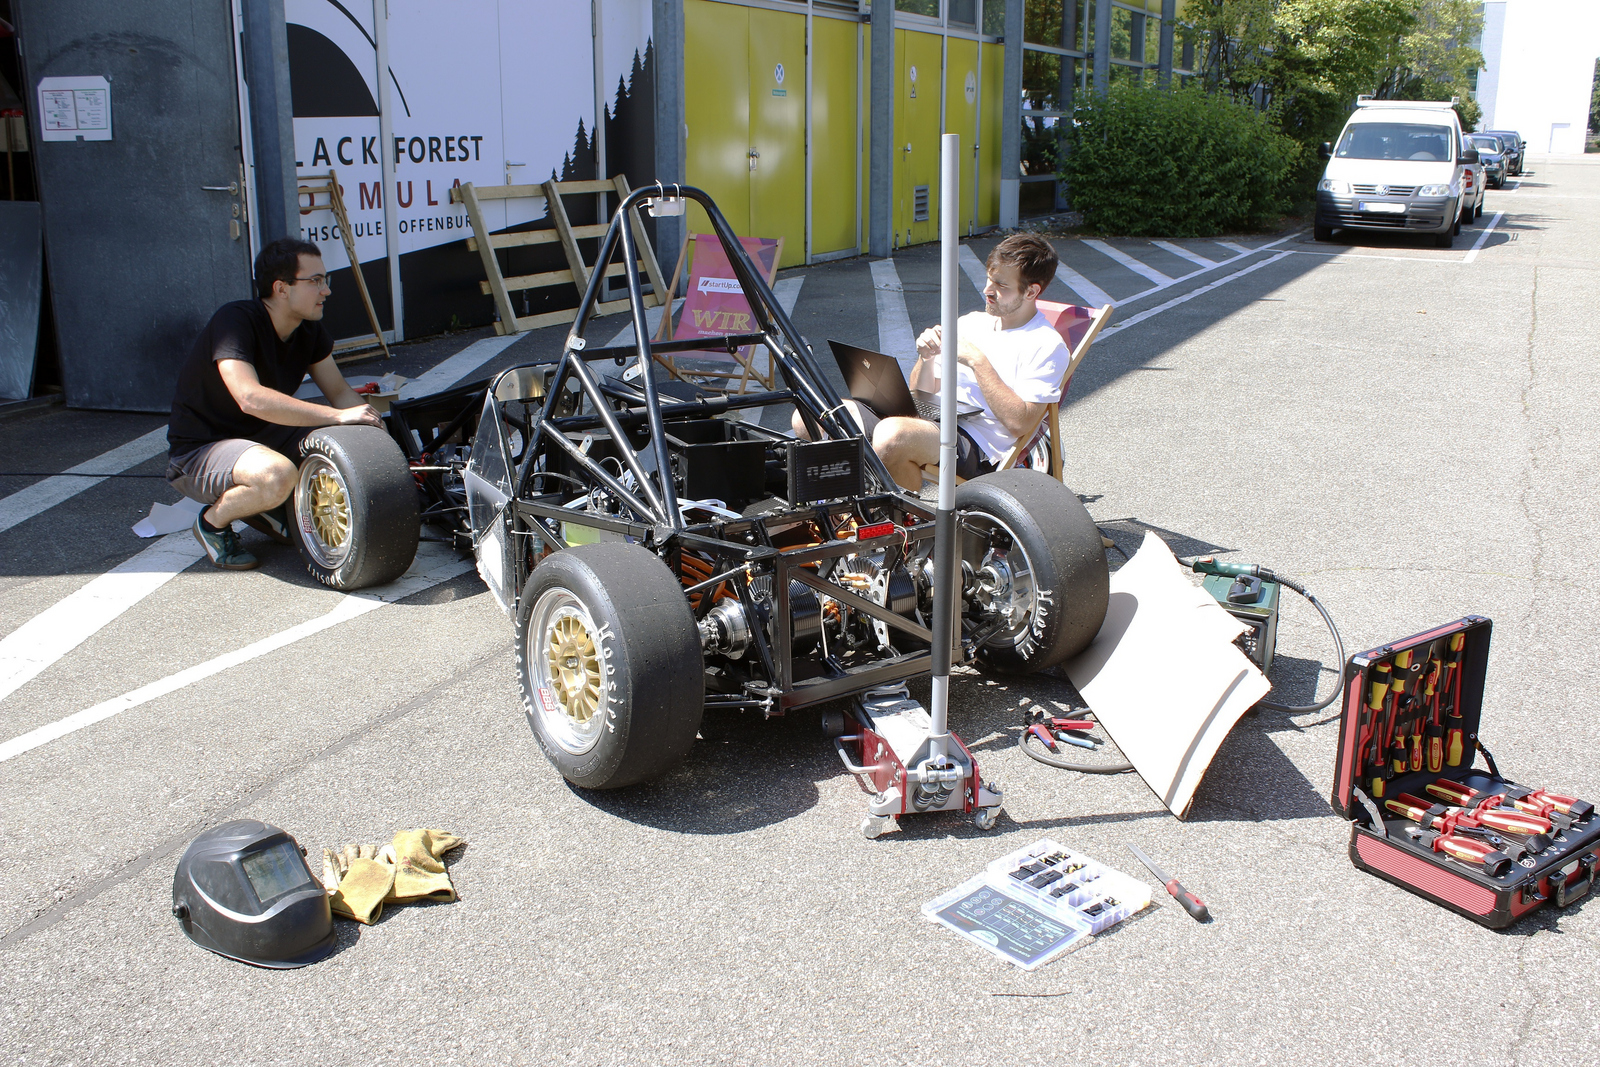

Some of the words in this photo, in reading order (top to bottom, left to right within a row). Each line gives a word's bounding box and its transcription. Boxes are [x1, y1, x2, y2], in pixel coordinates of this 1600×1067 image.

[394, 135, 483, 164] FOREST
[692, 309, 751, 331] WIR
[598, 620, 624, 734] Hoosier
[538, 687, 556, 712] BBS
